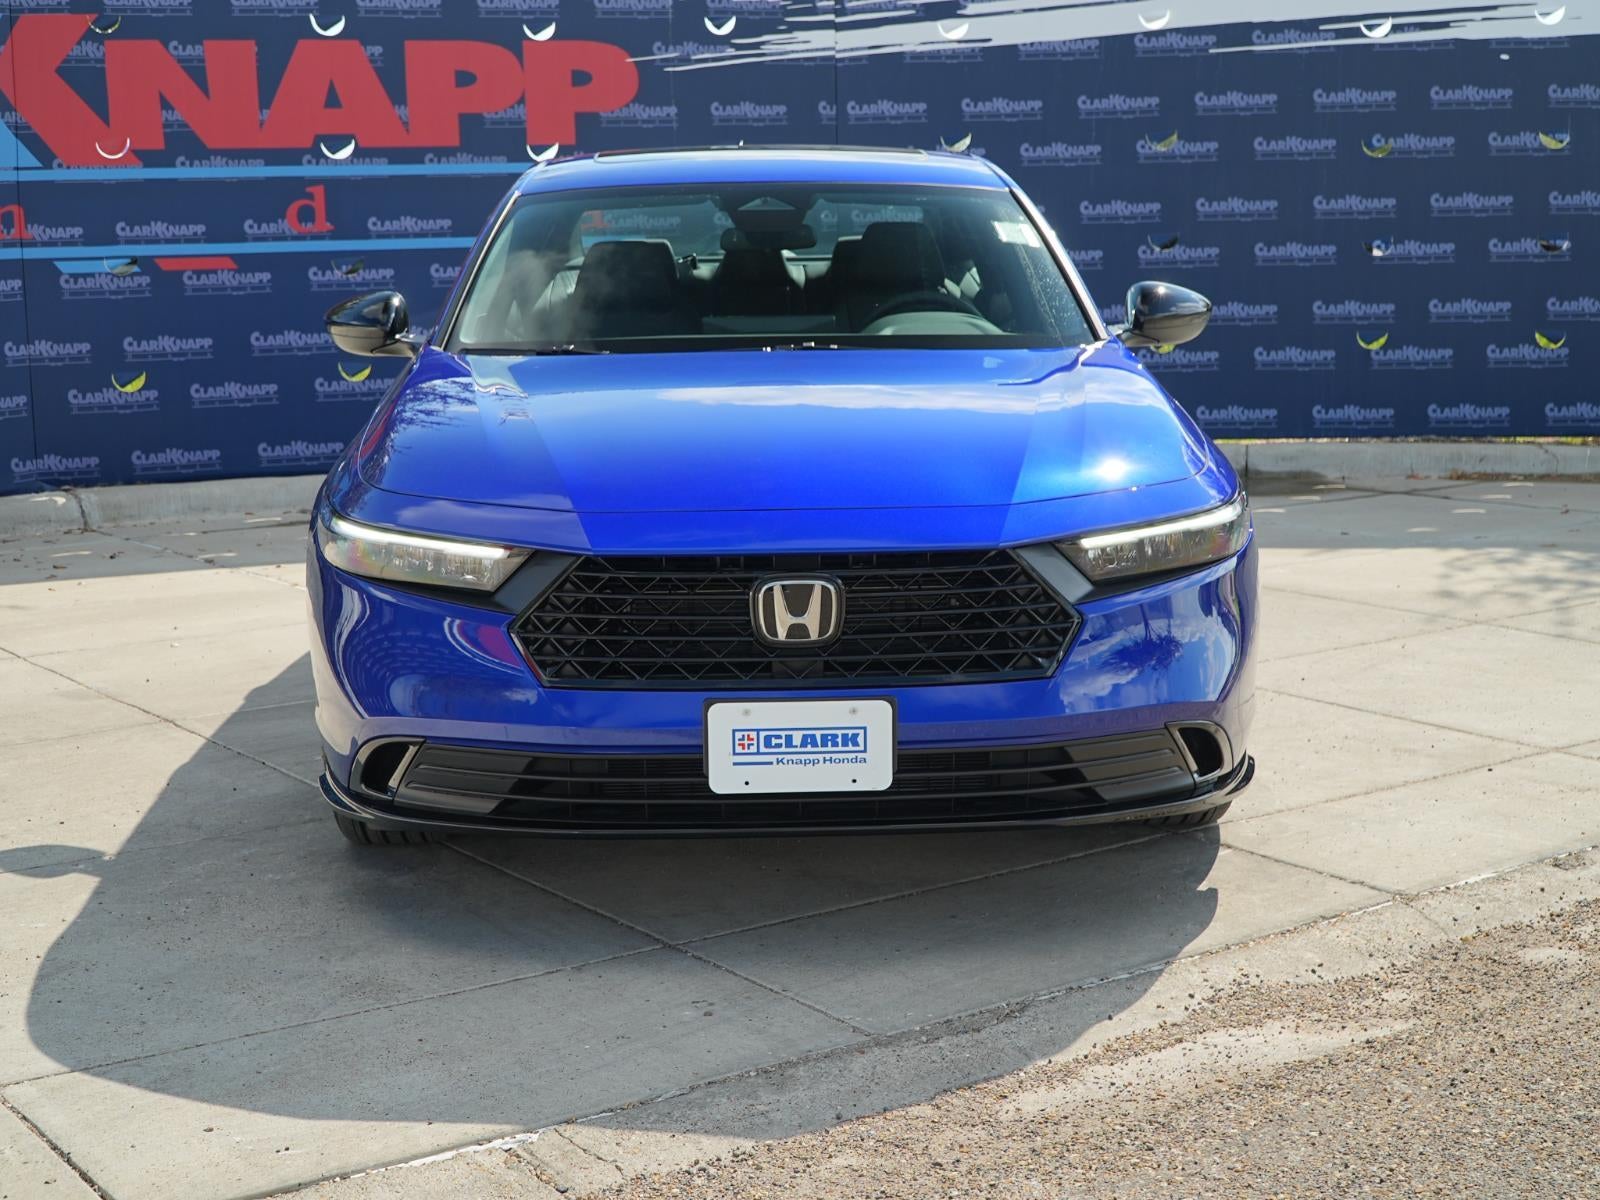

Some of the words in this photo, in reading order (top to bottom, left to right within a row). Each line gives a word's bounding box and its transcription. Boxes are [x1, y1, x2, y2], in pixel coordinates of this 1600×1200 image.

[0, 13, 639, 167] KNAPP
[286, 184, 334, 233] d
[763, 732, 860, 749] CLARK
[776, 756, 820, 766] Knapp
[823, 755, 867, 764] Honda
